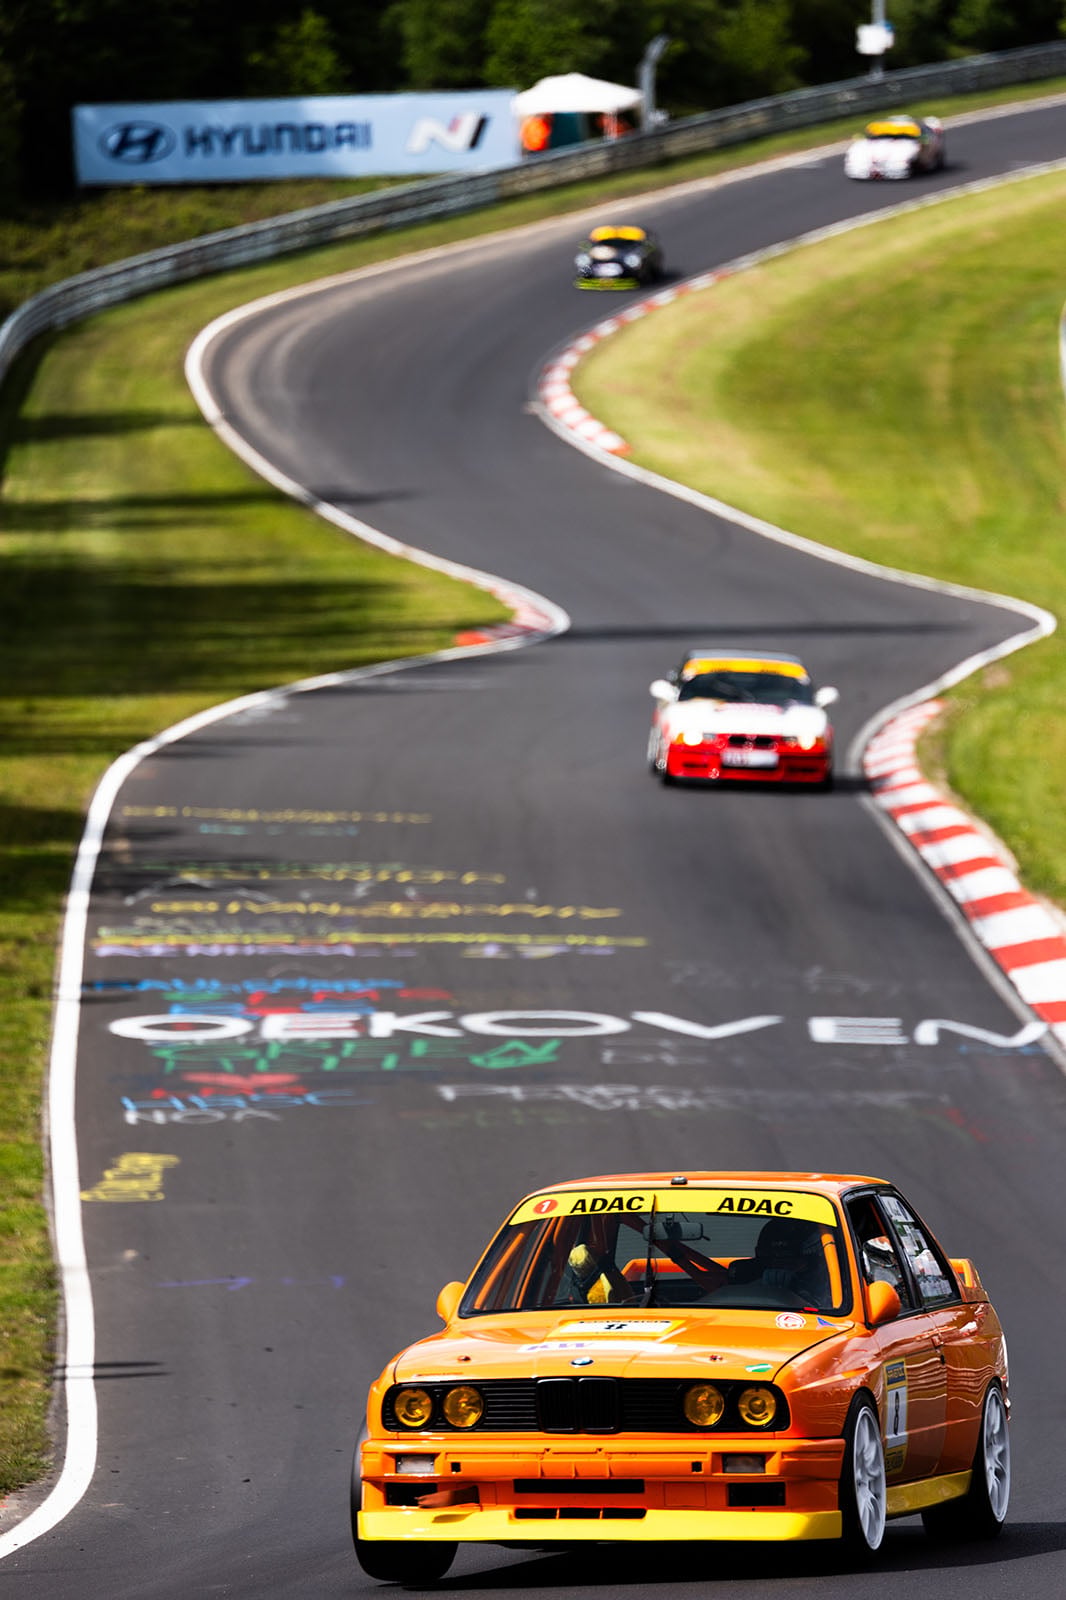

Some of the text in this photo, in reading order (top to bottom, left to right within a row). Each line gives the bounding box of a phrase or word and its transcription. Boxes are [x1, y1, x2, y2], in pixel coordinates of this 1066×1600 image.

[184, 119, 372, 157] HYUNDAI
[570, 1196, 645, 1214] ADAC
[717, 1196, 793, 1215] ADAC
